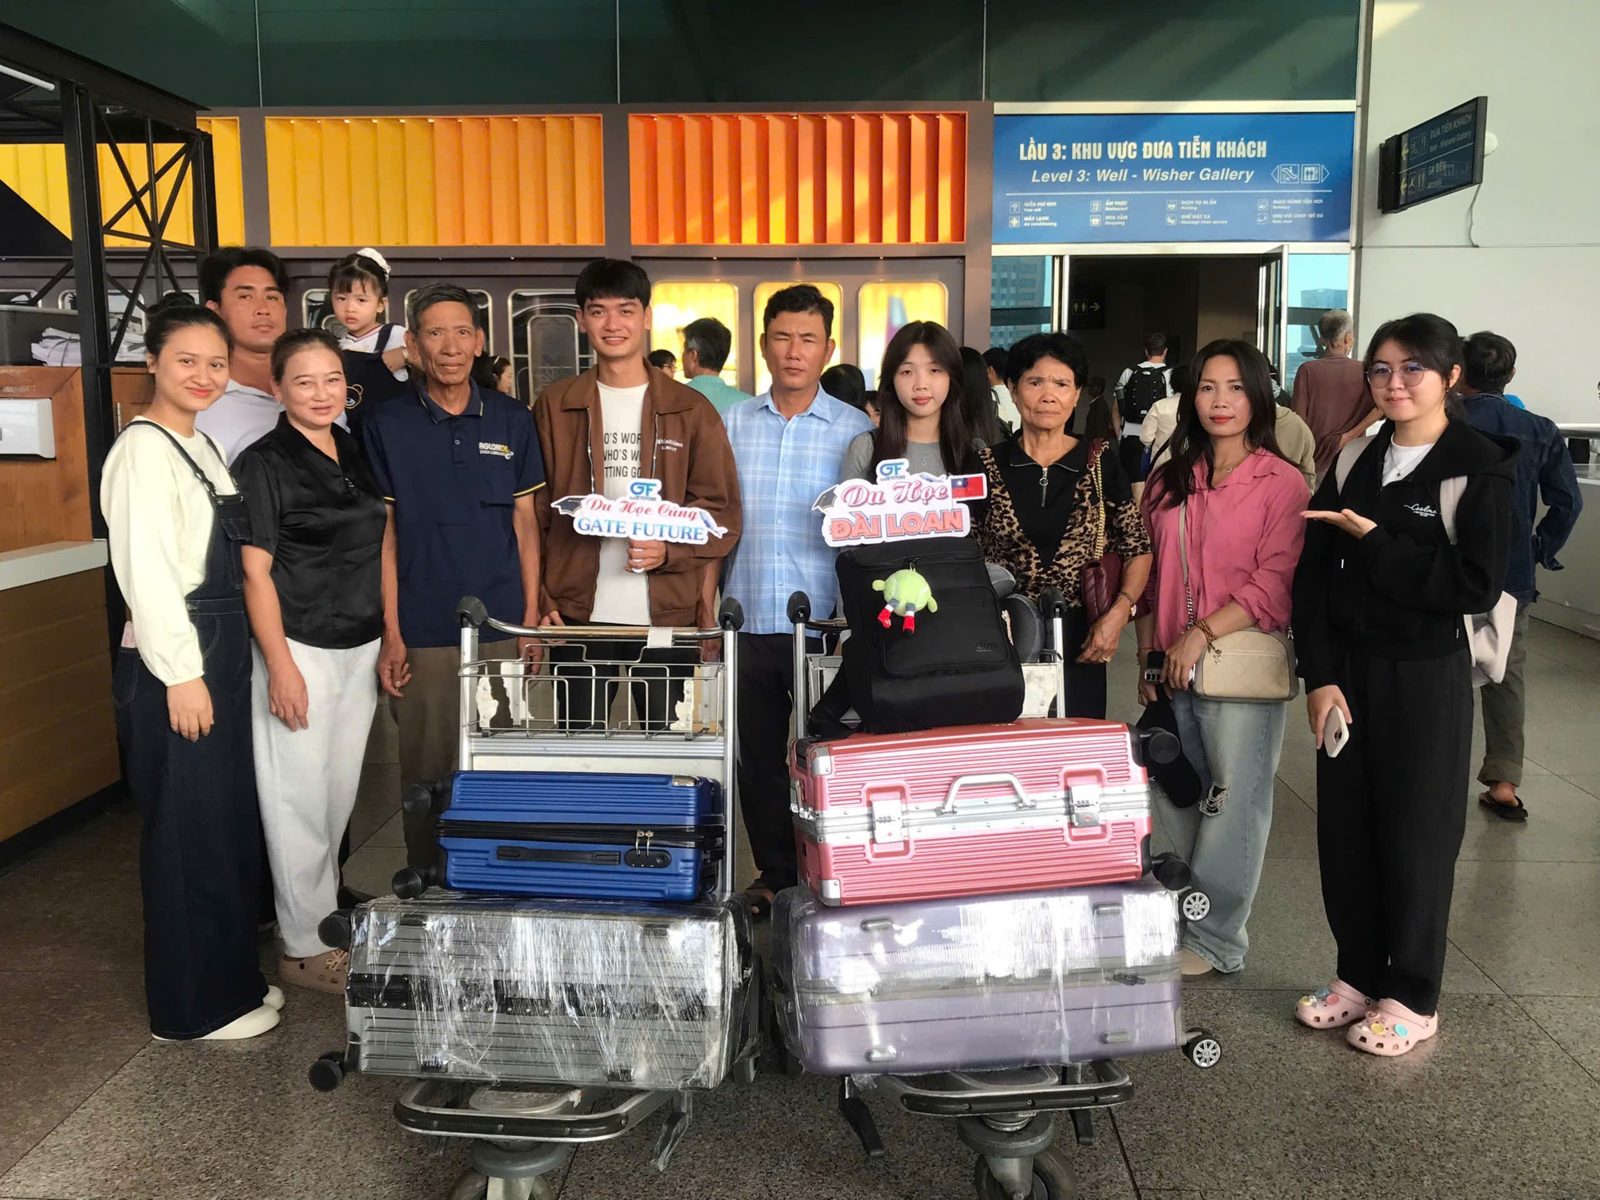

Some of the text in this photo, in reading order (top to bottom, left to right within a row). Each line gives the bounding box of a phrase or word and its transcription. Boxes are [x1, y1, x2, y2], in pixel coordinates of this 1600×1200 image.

[1019, 135, 1267, 163] LẦU 3: KHU VỰC ĐƯA TIỄN KHÁCH
[1031, 169, 1073, 183] Level
[1076, 169, 1091, 182] 3:
[1096, 168, 1128, 182] Well
[1142, 168, 1195, 181] Wisher
[1199, 167, 1255, 184] Gallery
[842, 481, 949, 507] Du Học
[587, 499, 612, 512] Du
[619, 500, 652, 516] Học
[577, 517, 705, 541] GATE FUTURE
[830, 508, 964, 541] ĐÀI LOAN
